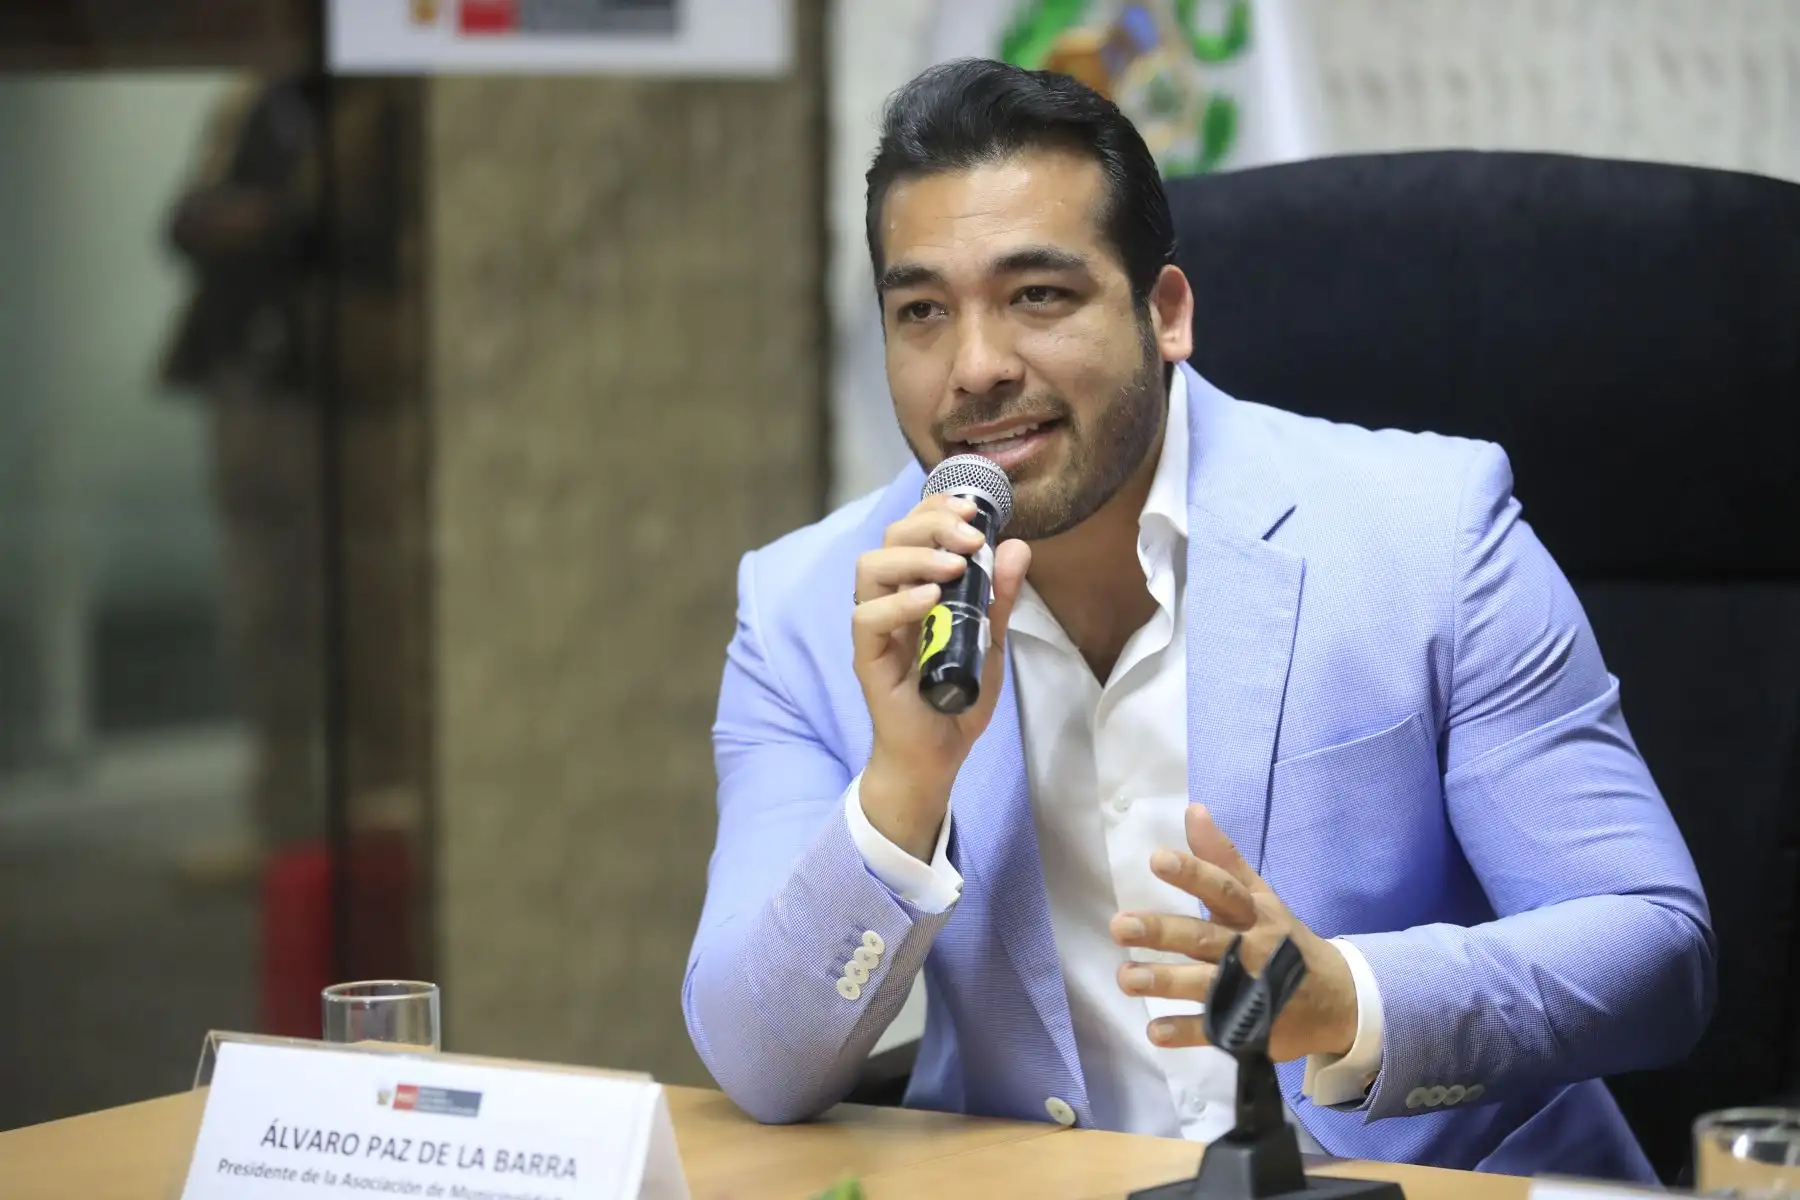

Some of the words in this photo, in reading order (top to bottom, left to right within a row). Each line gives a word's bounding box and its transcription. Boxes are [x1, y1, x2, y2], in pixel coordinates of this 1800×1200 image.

[260, 1118, 360, 1156] ÁLVARO
[366, 1135, 413, 1164] PAZ
[418, 1140, 450, 1167] DE
[456, 1144, 486, 1170] LA
[494, 1149, 577, 1180] BARRA
[217, 1158, 298, 1181] Presidente
[300, 1167, 321, 1184] de
[323, 1169, 338, 1186] la
